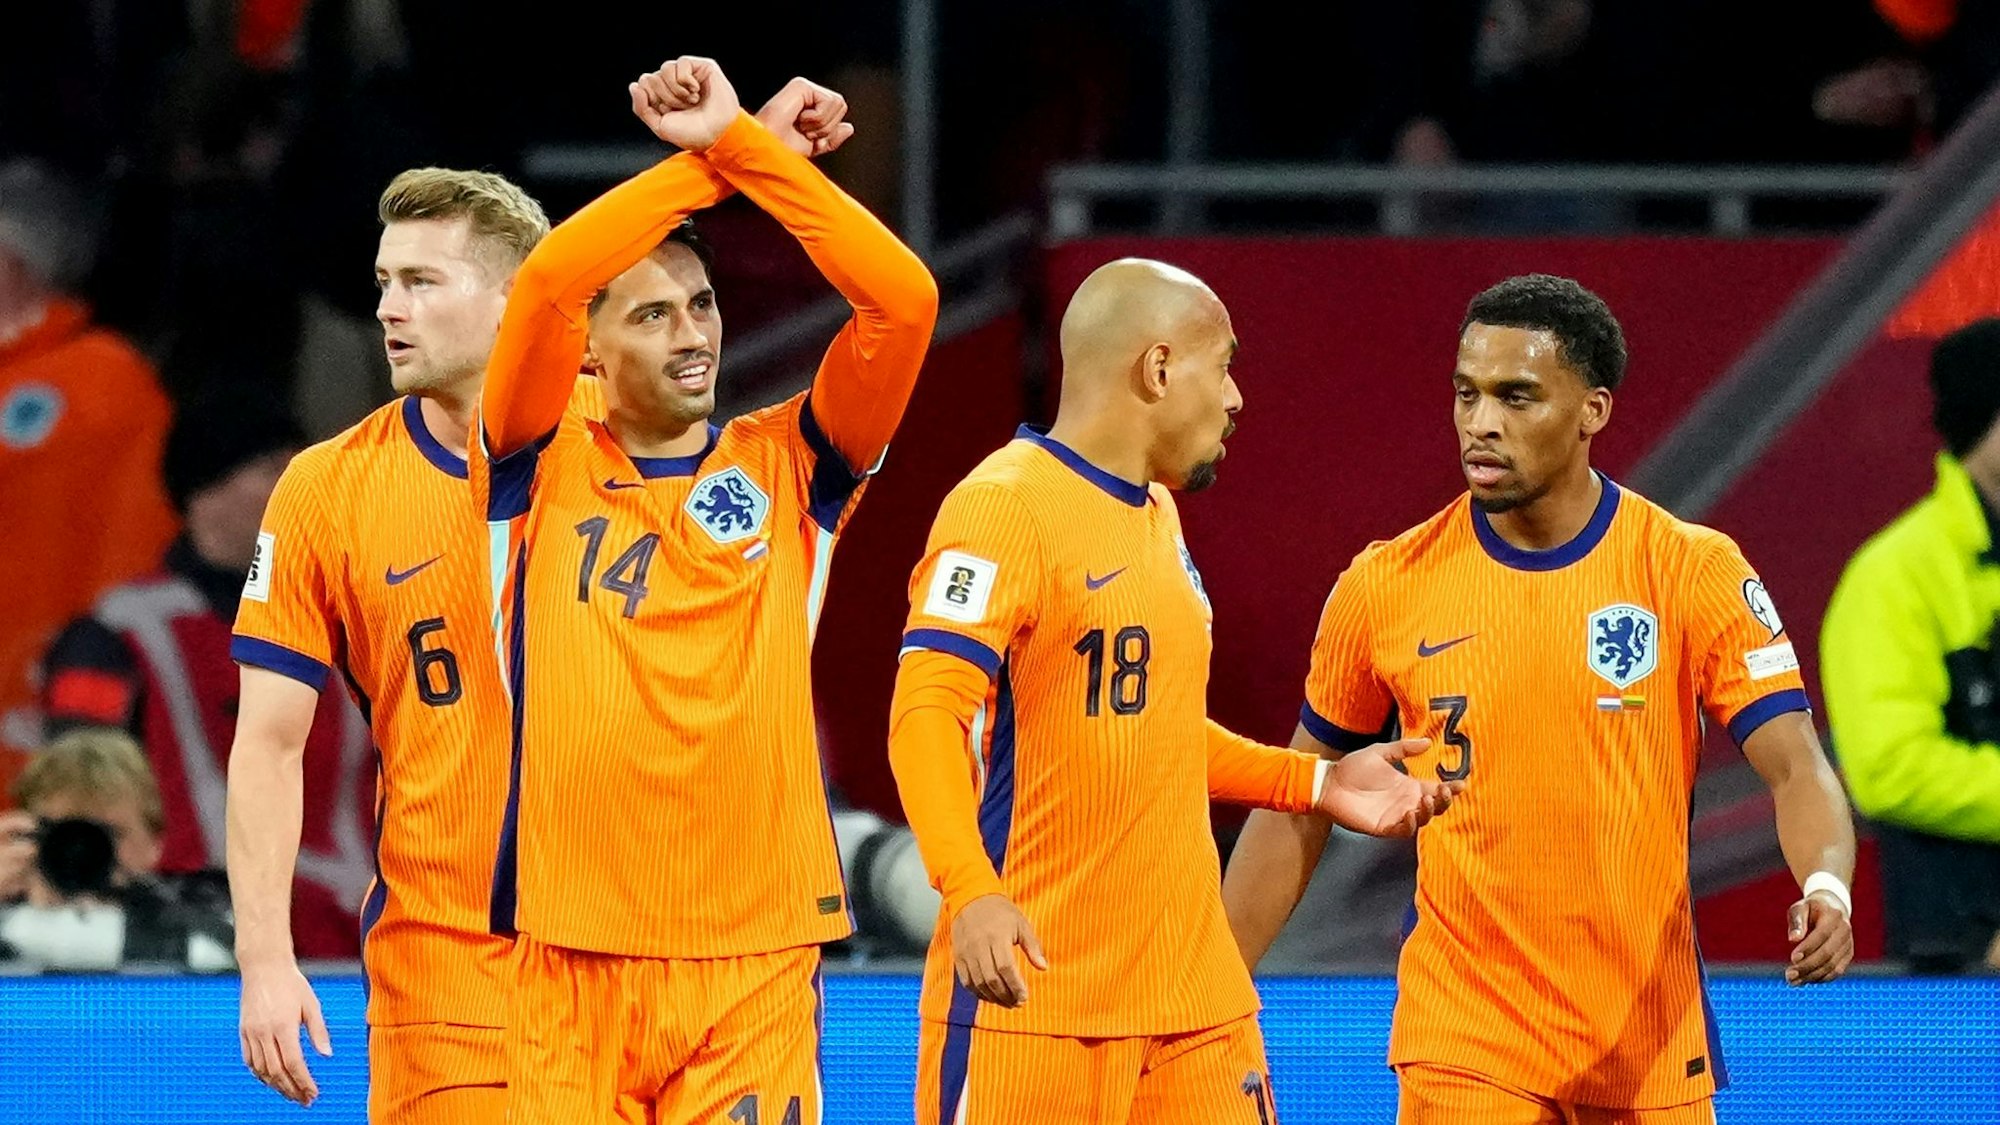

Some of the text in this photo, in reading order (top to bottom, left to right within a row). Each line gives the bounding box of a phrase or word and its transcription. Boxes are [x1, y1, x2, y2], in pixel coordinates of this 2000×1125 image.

[574, 516, 661, 619] 14
[407, 616, 462, 707] 6
[1073, 625, 1150, 717] 18
[1429, 695, 1471, 782] 3
